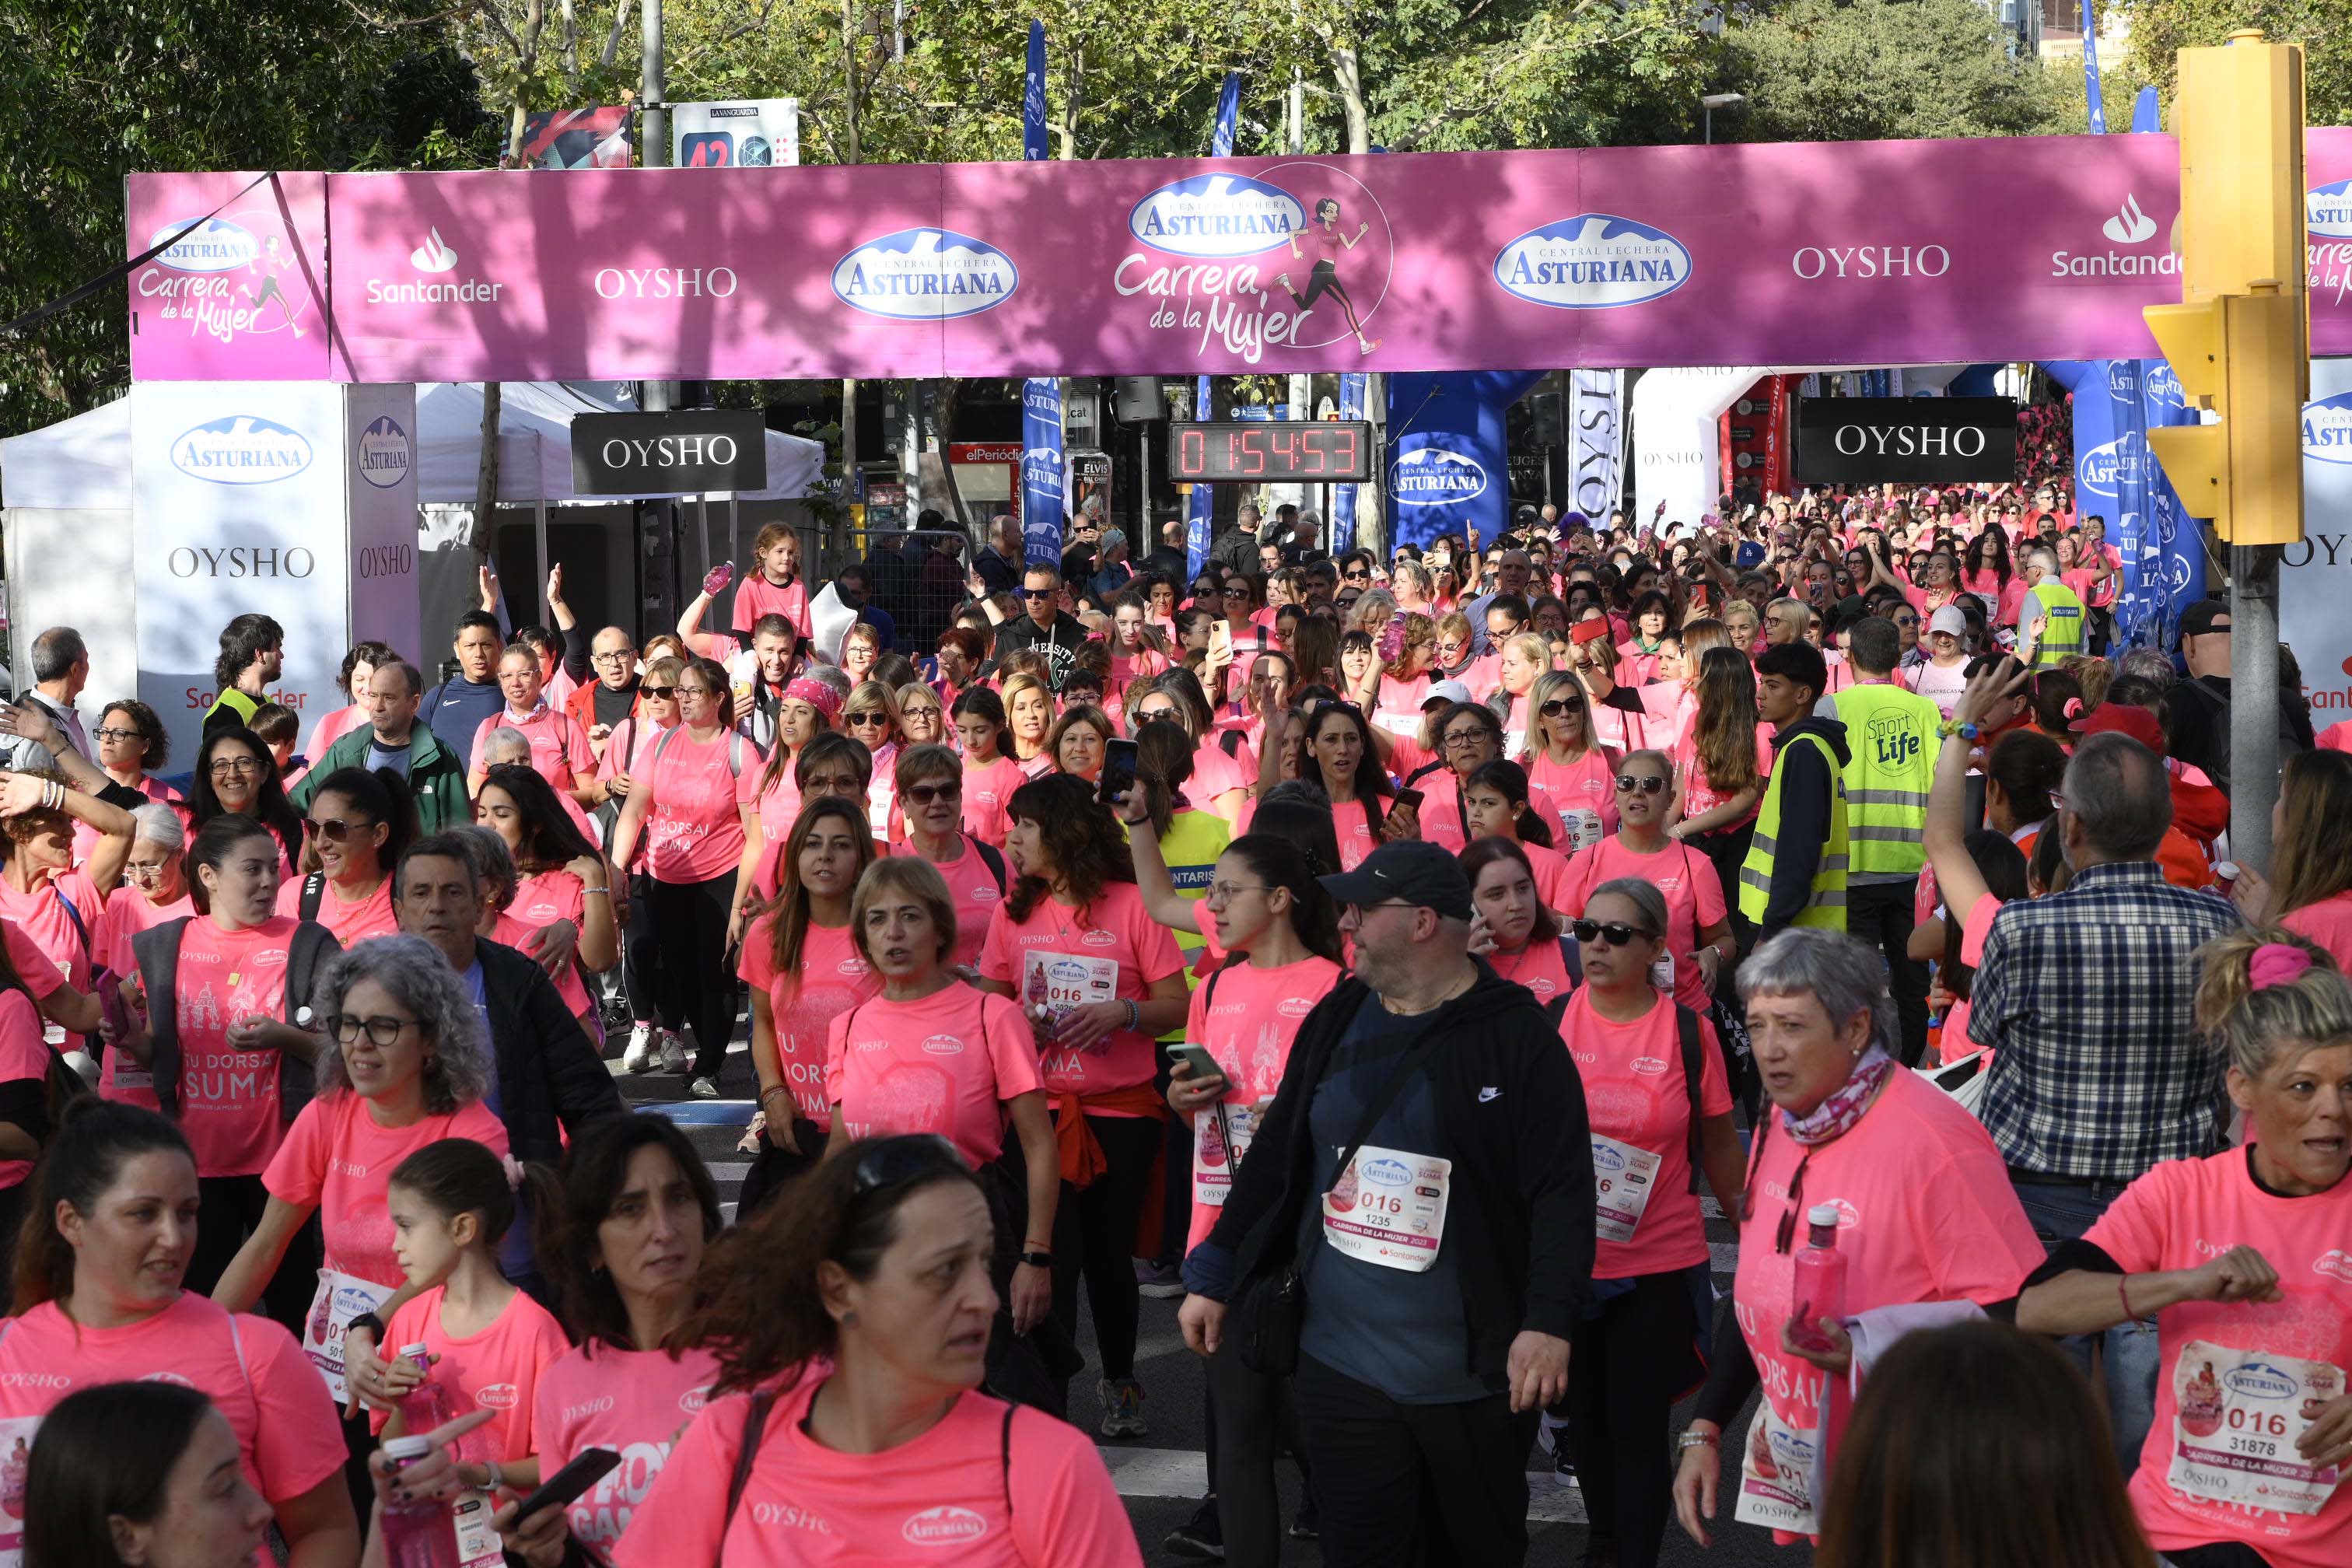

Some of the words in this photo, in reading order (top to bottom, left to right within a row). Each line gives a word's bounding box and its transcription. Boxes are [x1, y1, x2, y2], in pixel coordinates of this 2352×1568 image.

[719, 107, 758, 117] VANGUARDIA
[1143, 205, 1293, 236] ASTURIANA
[939, 258, 997, 268] LECHERA
[1539, 246, 1600, 257] CENTRAL
[1607, 245, 1670, 255] LECHERA
[1792, 244, 1951, 278] OYSHO
[845, 261, 1004, 296] ASTURIANA
[1114, 253, 1260, 296] Carrera
[1509, 250, 1677, 285] ASTURIANA
[138, 268, 230, 297] Carrera
[366, 278, 503, 303] Santander
[594, 267, 738, 299] OYSHO
[160, 298, 177, 319] de
[180, 298, 194, 319] la
[191, 296, 264, 343] Mujer
[1150, 298, 1177, 328] de
[1182, 297, 1202, 328] la
[1198, 290, 1314, 364] Mujer
[603, 436, 737, 468] OYSHO
[1181, 431, 1354, 474] 01:54:53
[1835, 425, 1986, 457] OYSHO
[180, 441, 303, 467] ASTURIANA
[362, 443, 407, 471] ASTURIANA
[1644, 451, 1703, 466] OYSHO
[1083, 464, 1108, 473] ELVIS
[1391, 471, 1480, 492] ASTURIANA
[168, 547, 315, 578] OYSHO
[359, 543, 411, 579] OYSHO
[186, 687, 308, 709] Sader
[1867, 713, 1911, 740] Sport
[1876, 731, 1920, 765] Life
[1020, 934, 1055, 945] OYSHO
[180, 950, 222, 964] OYSHO
[1050, 967, 1086, 979] ASTURIANA
[1050, 987, 1082, 1002] 016
[1364, 1165, 1409, 1182] ASTURIANA
[1418, 1171, 1444, 1181] SUMA
[1361, 1192, 1402, 1213] 016
[1366, 1213, 1391, 1227] 1235
[1332, 1220, 1363, 1234] CARRERA
[1374, 1230, 1384, 1238] LA
[1384, 1231, 1409, 1243] MUJER
[1410, 1237, 1428, 1246] 2023
[1388, 1248, 1428, 1263] Santander
[1, 1372, 71, 1389] OYSHO
[1750, 1343, 1822, 1408] ORSAL
[2229, 1374, 2294, 1395] ASTURIANA
[2228, 1408, 2287, 1436] 016
[2229, 1437, 2277, 1457] 31878
[2231, 1456, 2246, 1467] DE
[2246, 1459, 2261, 1470] LA
[2263, 1461, 2298, 1476] MUJER
[2271, 1486, 2325, 1502] Santander
